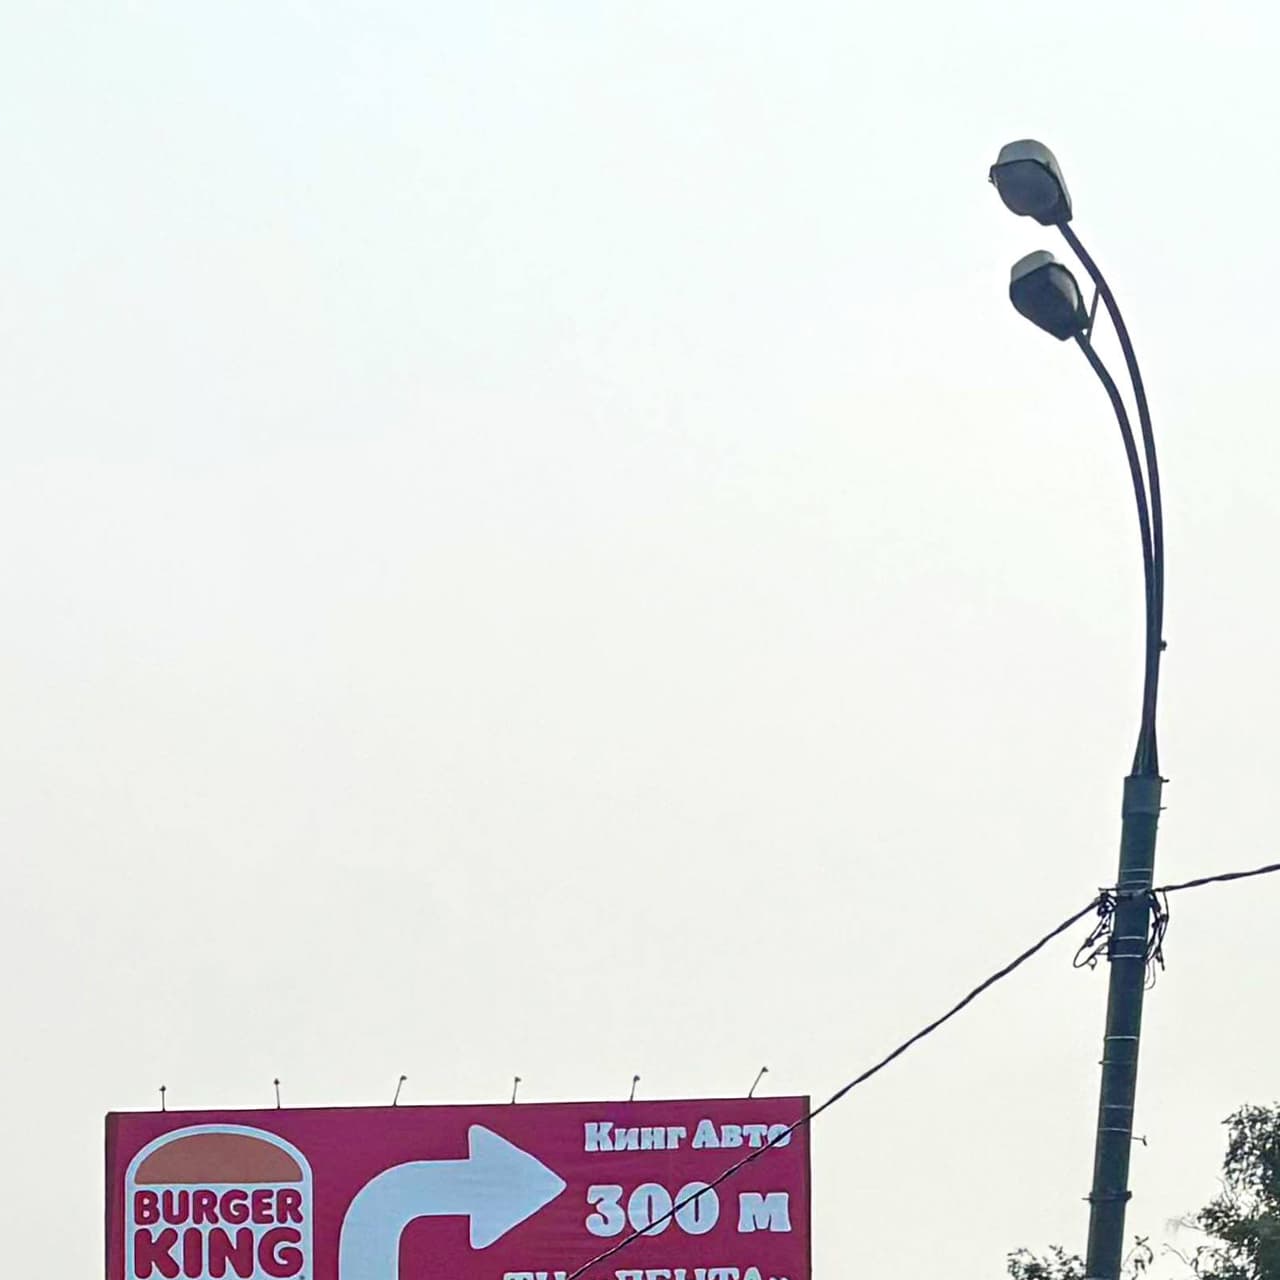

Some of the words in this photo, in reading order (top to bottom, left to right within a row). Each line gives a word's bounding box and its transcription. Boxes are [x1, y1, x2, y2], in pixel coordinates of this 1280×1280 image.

[584, 1121, 688, 1152] Кинг
[691, 1119, 792, 1149] Авто
[133, 1187, 305, 1227] BURGER
[585, 1181, 720, 1238] 300
[133, 1226, 305, 1280] KING
